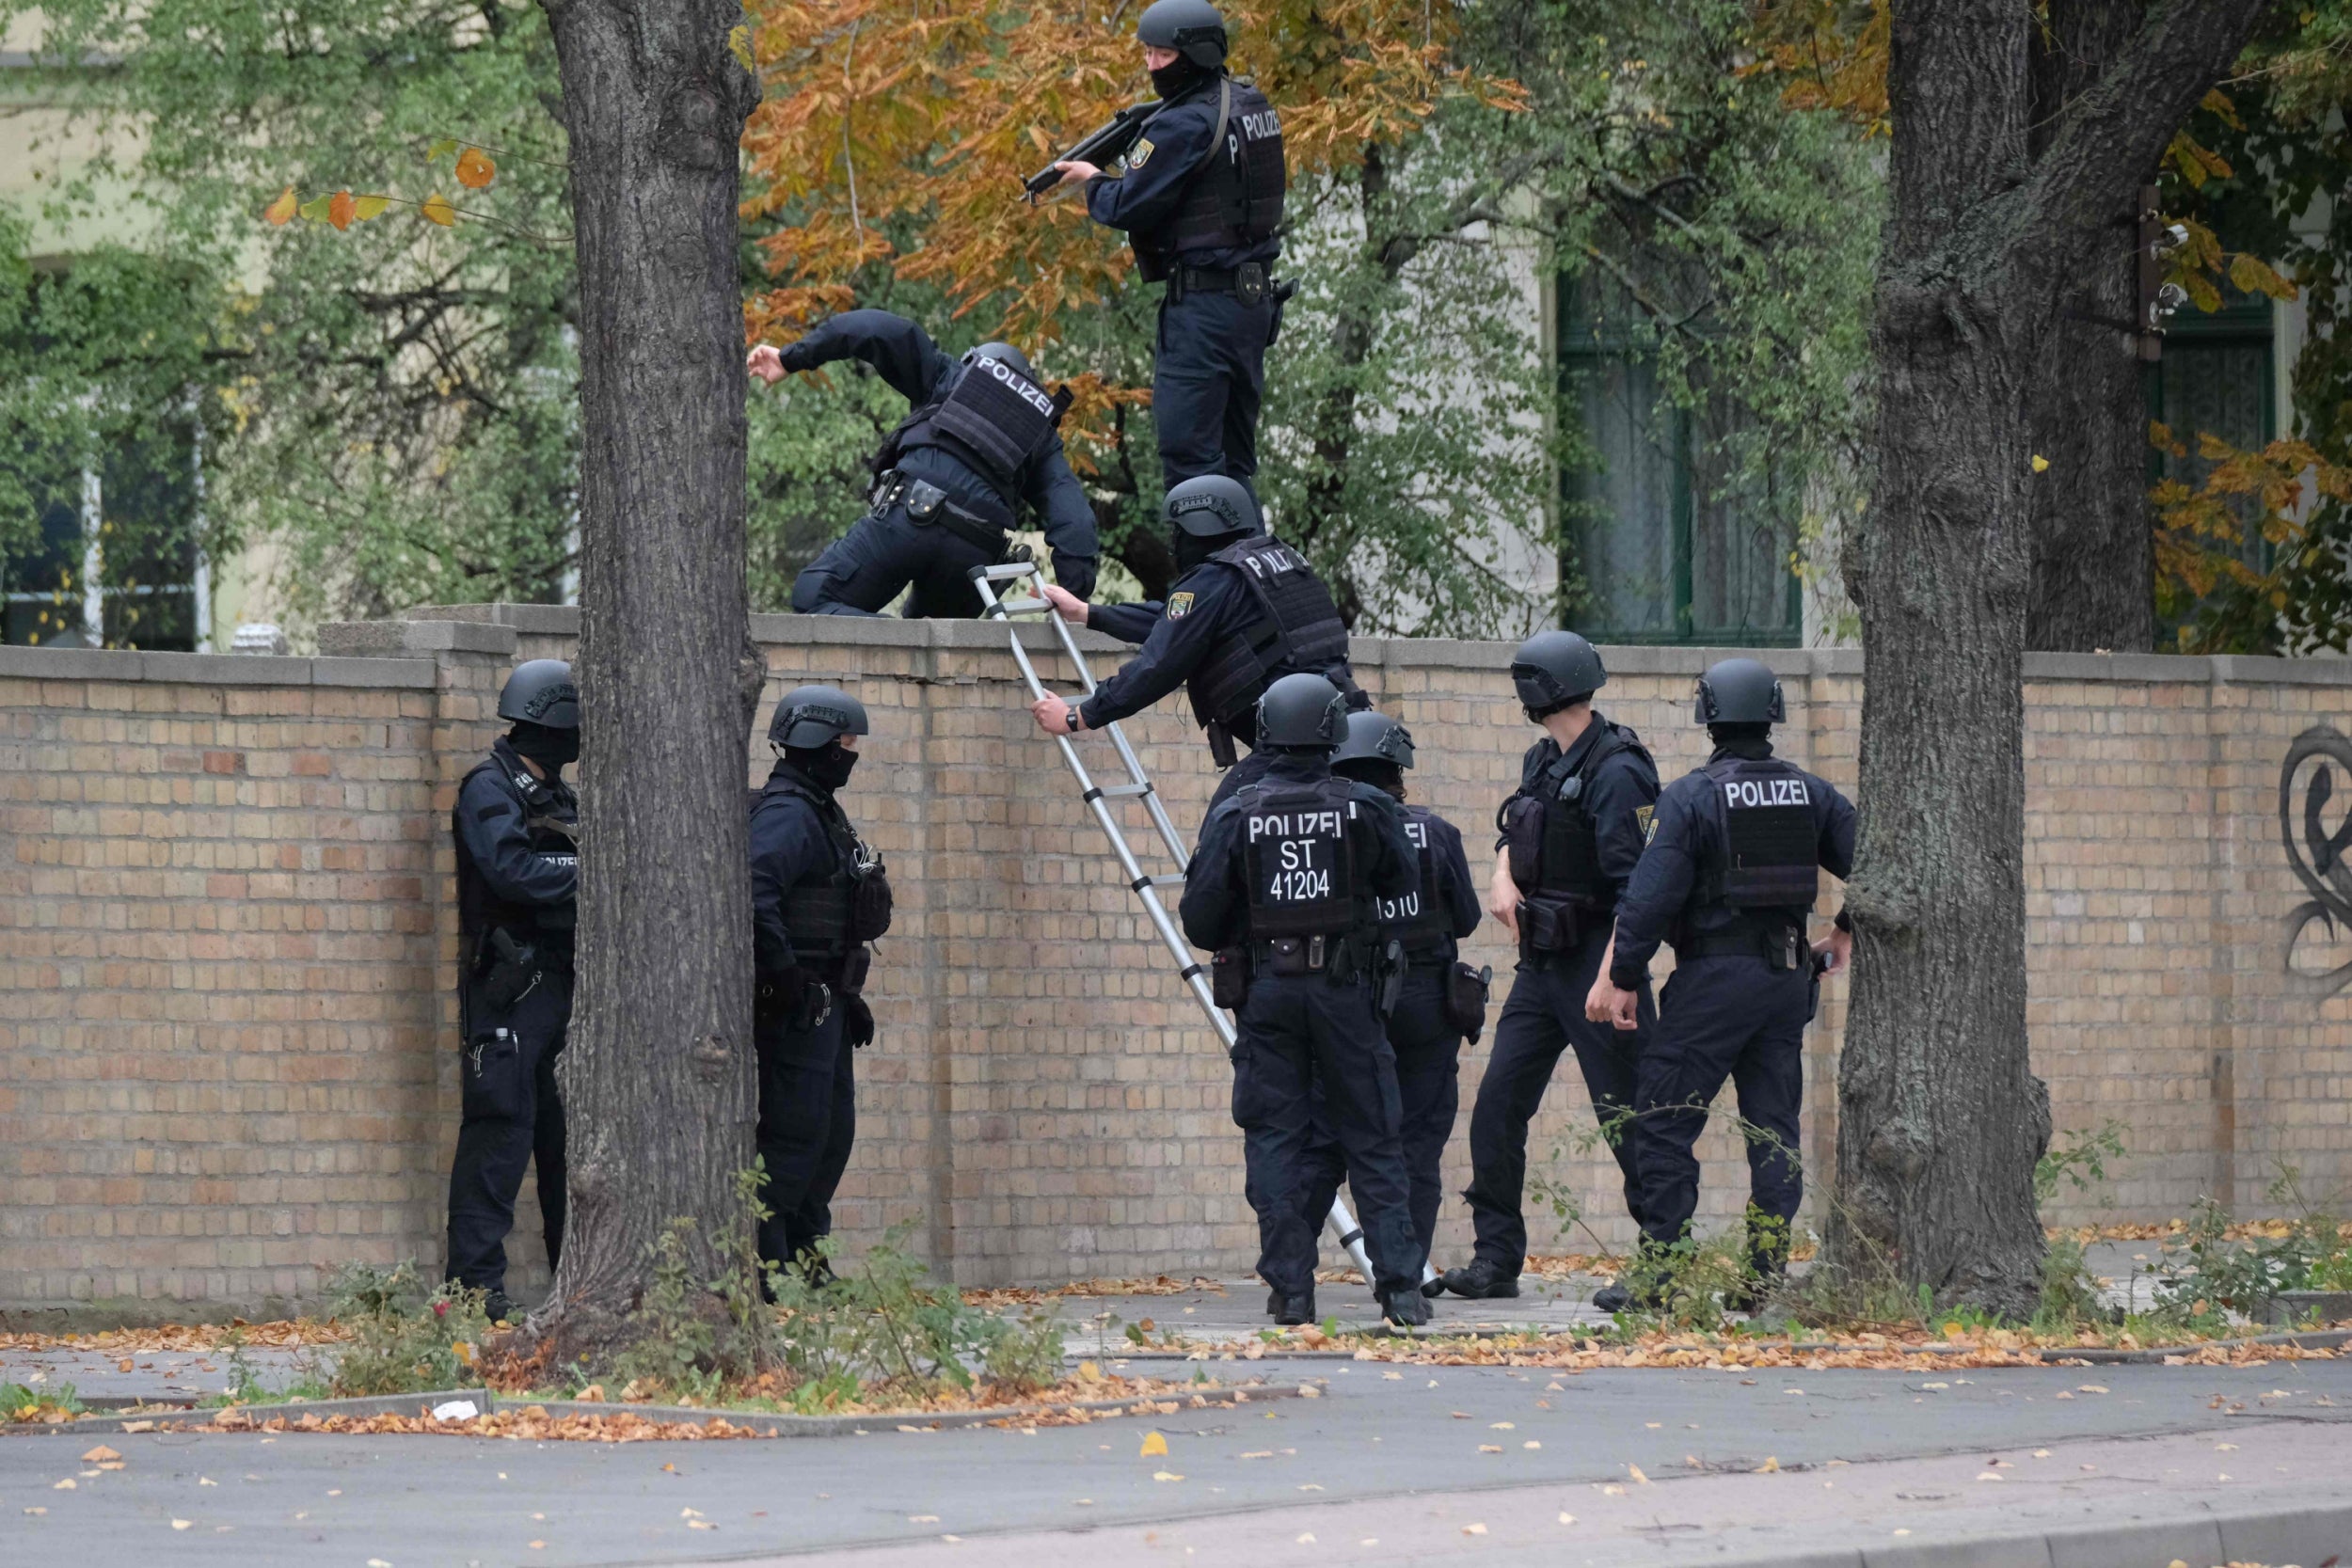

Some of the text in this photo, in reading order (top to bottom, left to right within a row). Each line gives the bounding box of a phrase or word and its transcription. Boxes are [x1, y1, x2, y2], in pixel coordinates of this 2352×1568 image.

[977, 356, 1055, 418] POLIZEI
[1724, 779, 1810, 808] POLIZEI
[1248, 811, 1342, 843] POLIZEI
[1280, 839, 1316, 870] ST
[1270, 868, 1330, 900] 41204
